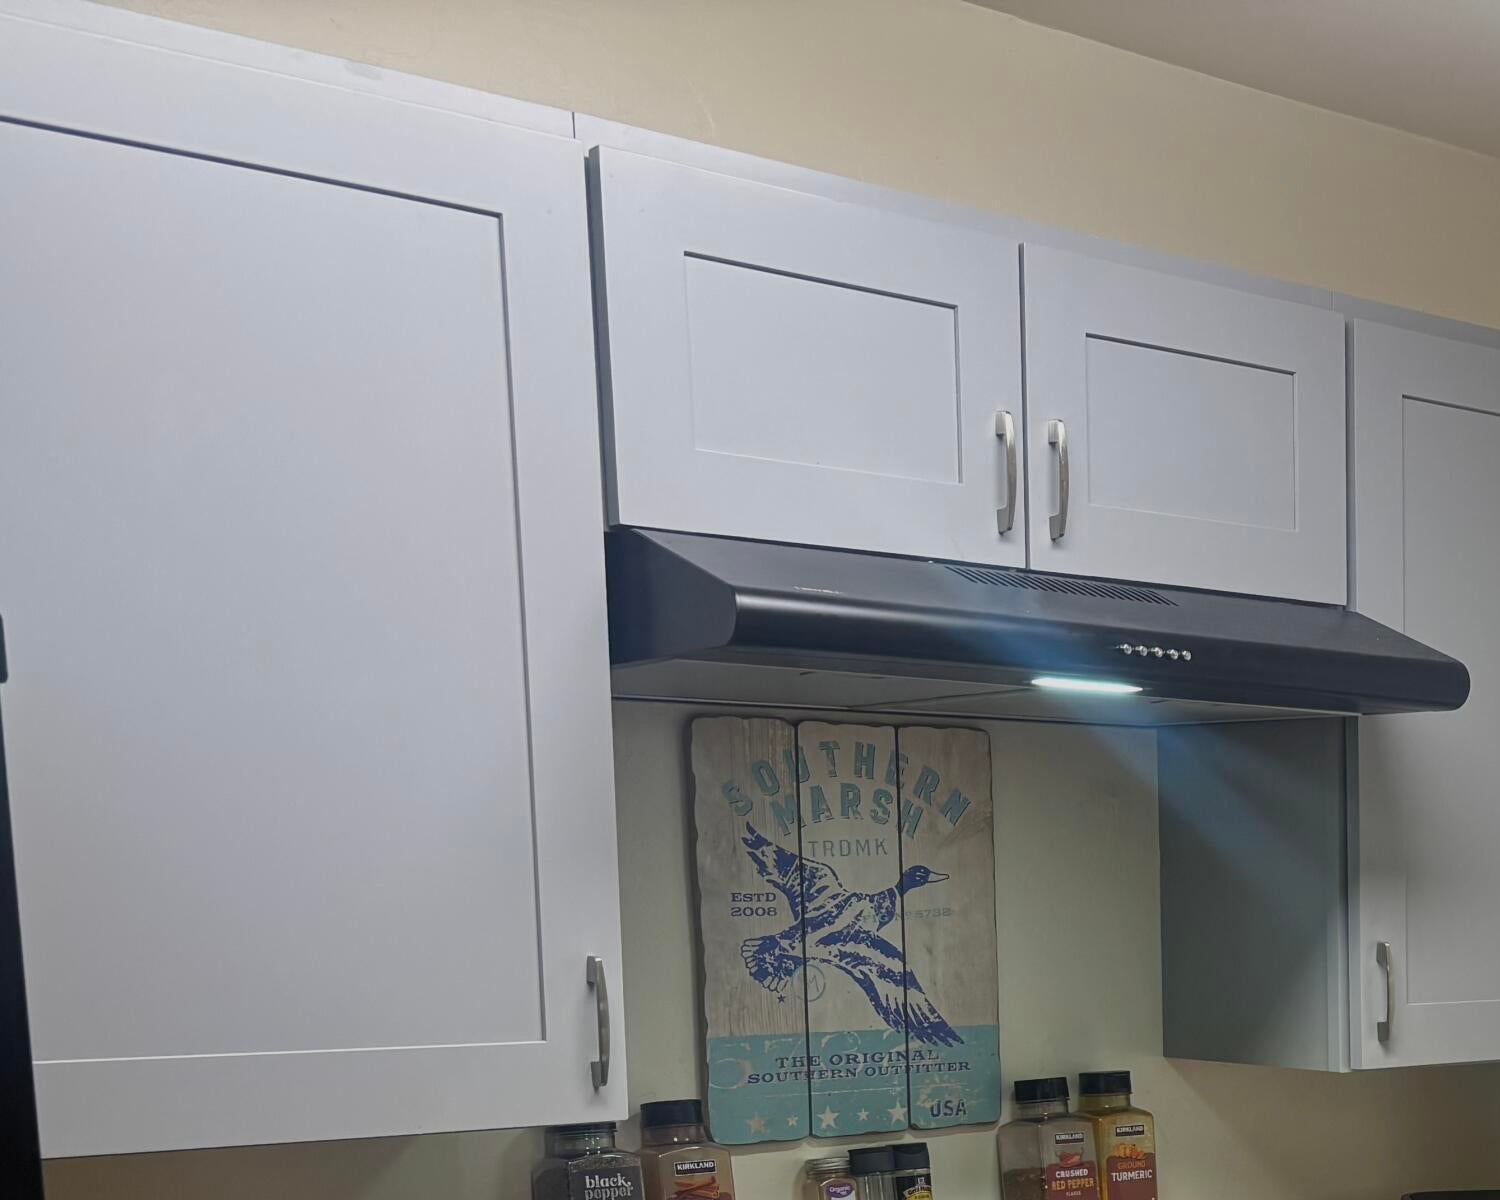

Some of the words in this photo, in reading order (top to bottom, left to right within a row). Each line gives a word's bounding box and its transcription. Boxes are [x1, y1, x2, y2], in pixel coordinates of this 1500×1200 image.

[722, 740, 972, 827] SOUTHERN
[770, 782, 924, 840] MARSH
[808, 837, 889, 858] TRDMK
[731, 892, 777, 902] ESTD
[730, 906, 778, 917] 2008
[775, 1055, 821, 1069] THE
[828, 1049, 940, 1066] ORIGINAL
[747, 1067, 858, 1085] SOUTHERN
[864, 1061, 971, 1078] OUTFITTER
[929, 1099, 968, 1118] USA
[676, 1160, 714, 1171] KIRKLAND
[1055, 1168, 1088, 1178] CRUSHED
[585, 1173, 632, 1188] black
[1111, 1169, 1153, 1182] TURMERIC
[1051, 1180, 1066, 1191] RED
[1067, 1177, 1094, 1189] PEPPER
